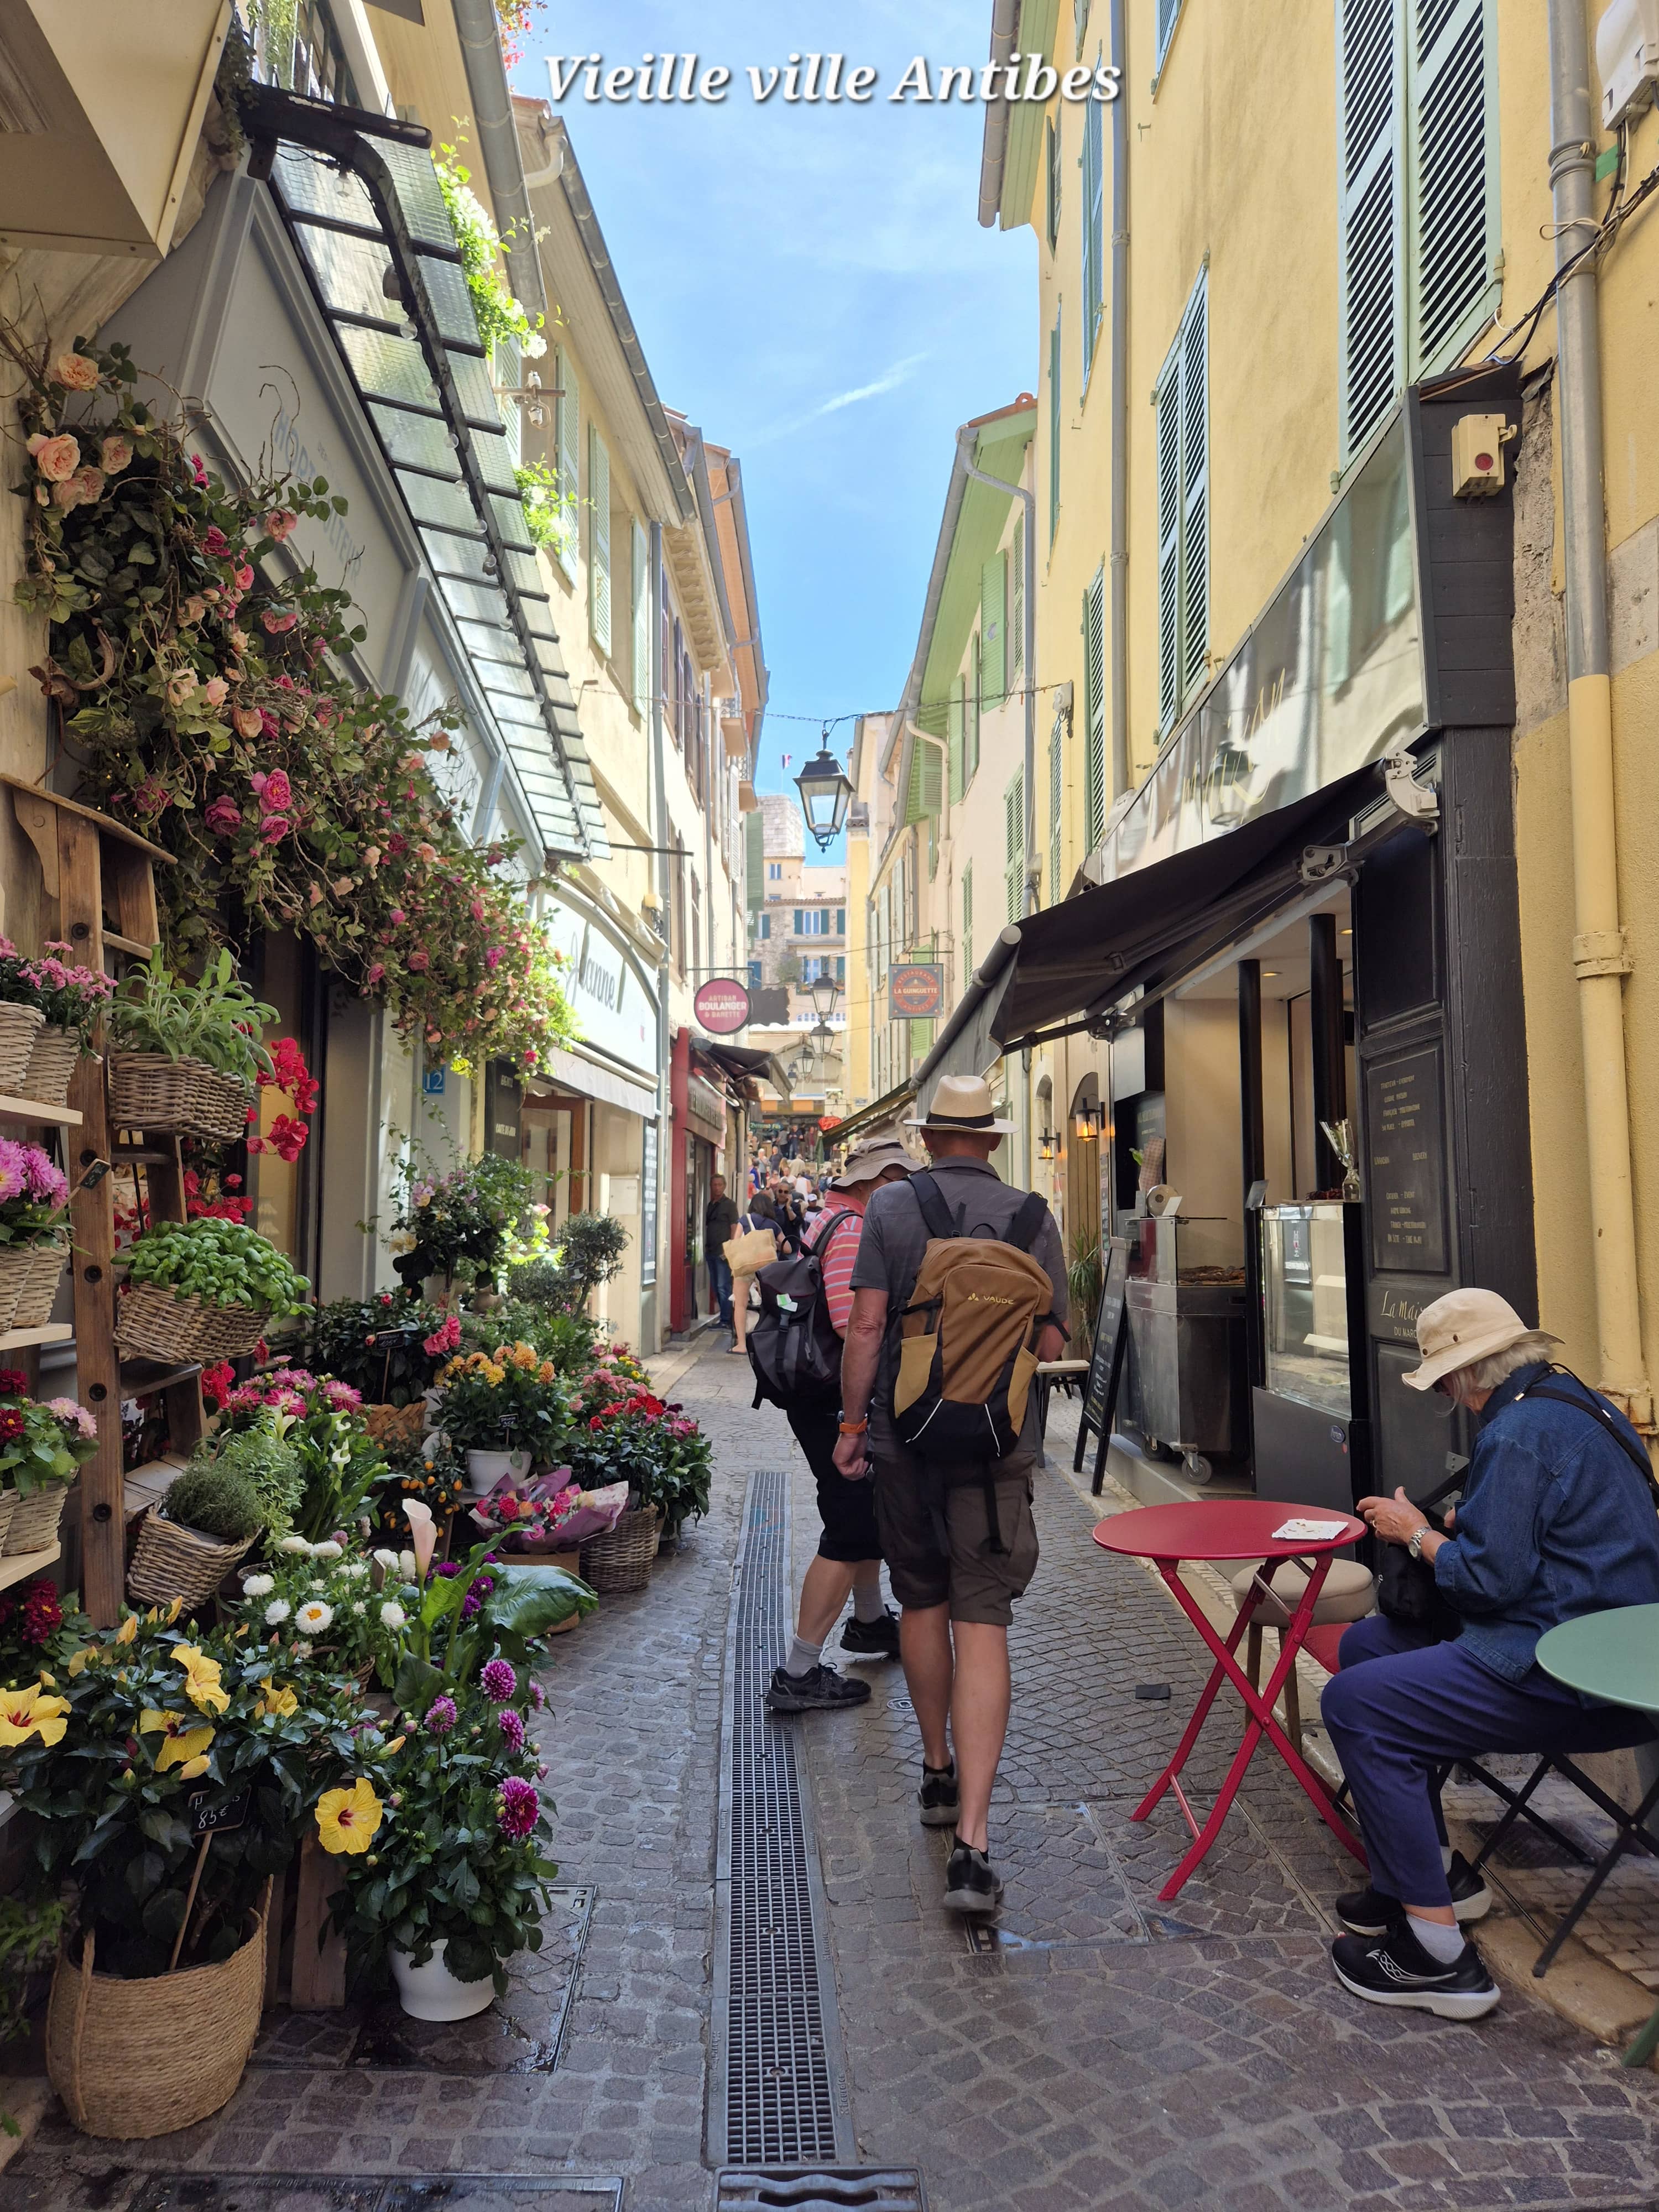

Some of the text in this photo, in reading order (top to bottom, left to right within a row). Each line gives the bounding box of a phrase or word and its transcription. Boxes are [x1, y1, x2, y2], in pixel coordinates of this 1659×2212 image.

[698, 1001, 747, 1011] BOULANGER
[426, 1072, 443, 1090] 12
[983, 1295, 1014, 1305] VAUDE
[1380, 1290, 1425, 1321] La Mai
[1394, 1327, 1417, 1339] DU MARC
